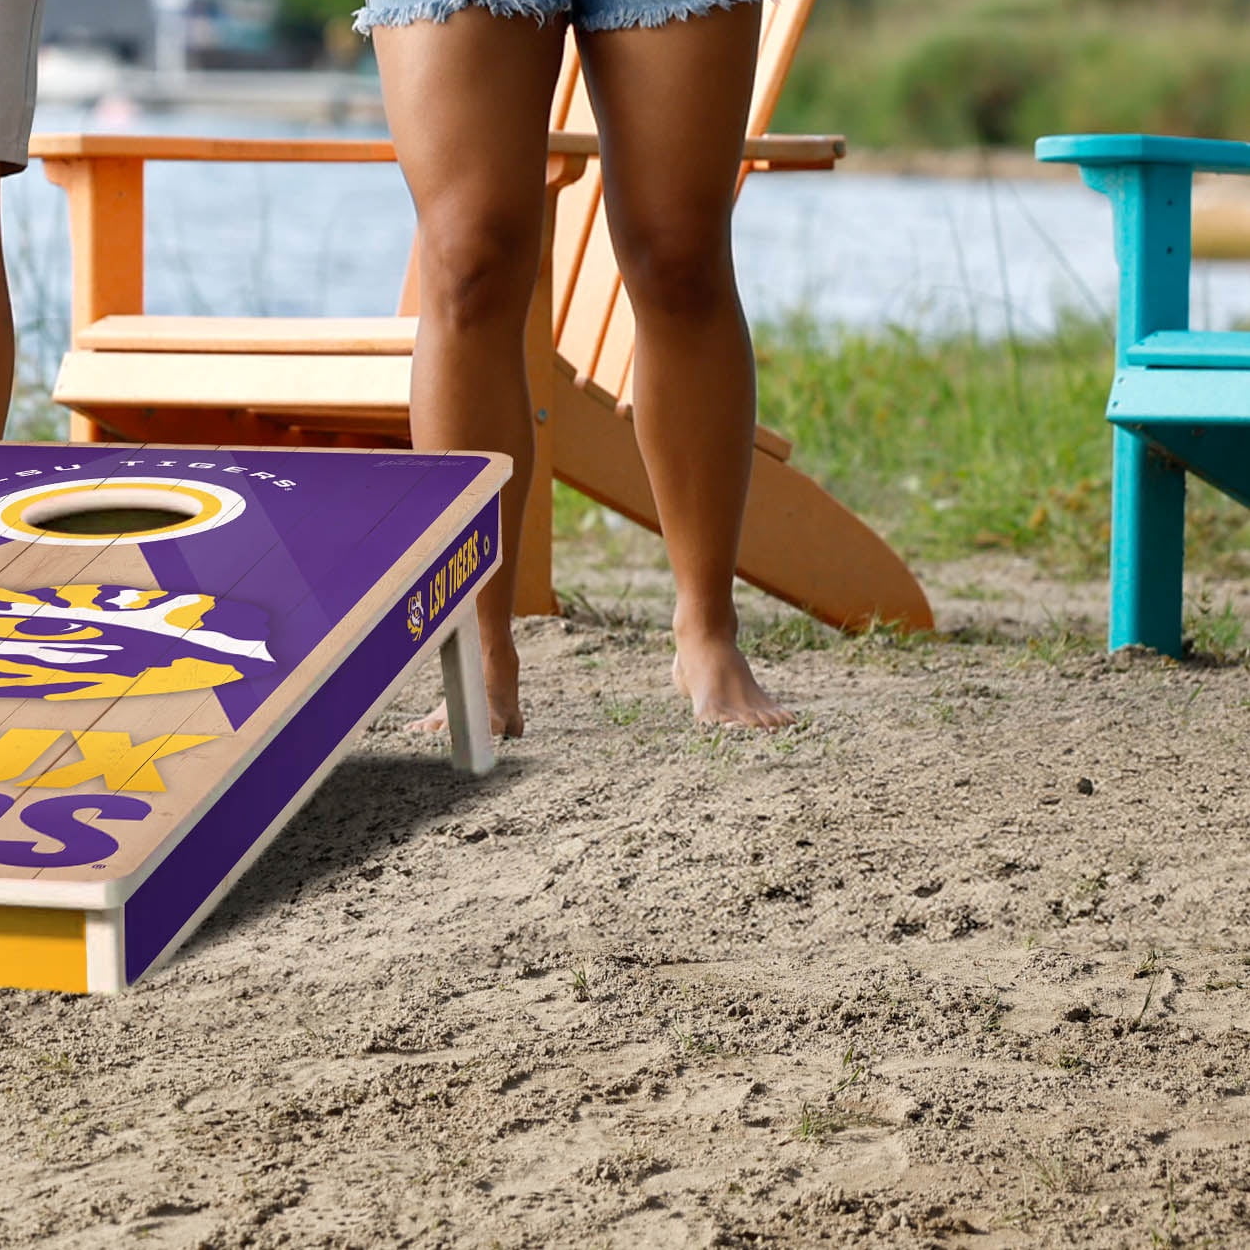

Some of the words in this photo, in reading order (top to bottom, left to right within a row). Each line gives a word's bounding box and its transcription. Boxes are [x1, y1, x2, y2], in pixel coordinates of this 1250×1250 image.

[119, 460, 297, 489] TIGERS
[429, 565, 447, 622] LSU
[448, 529, 480, 599] TIGERS
